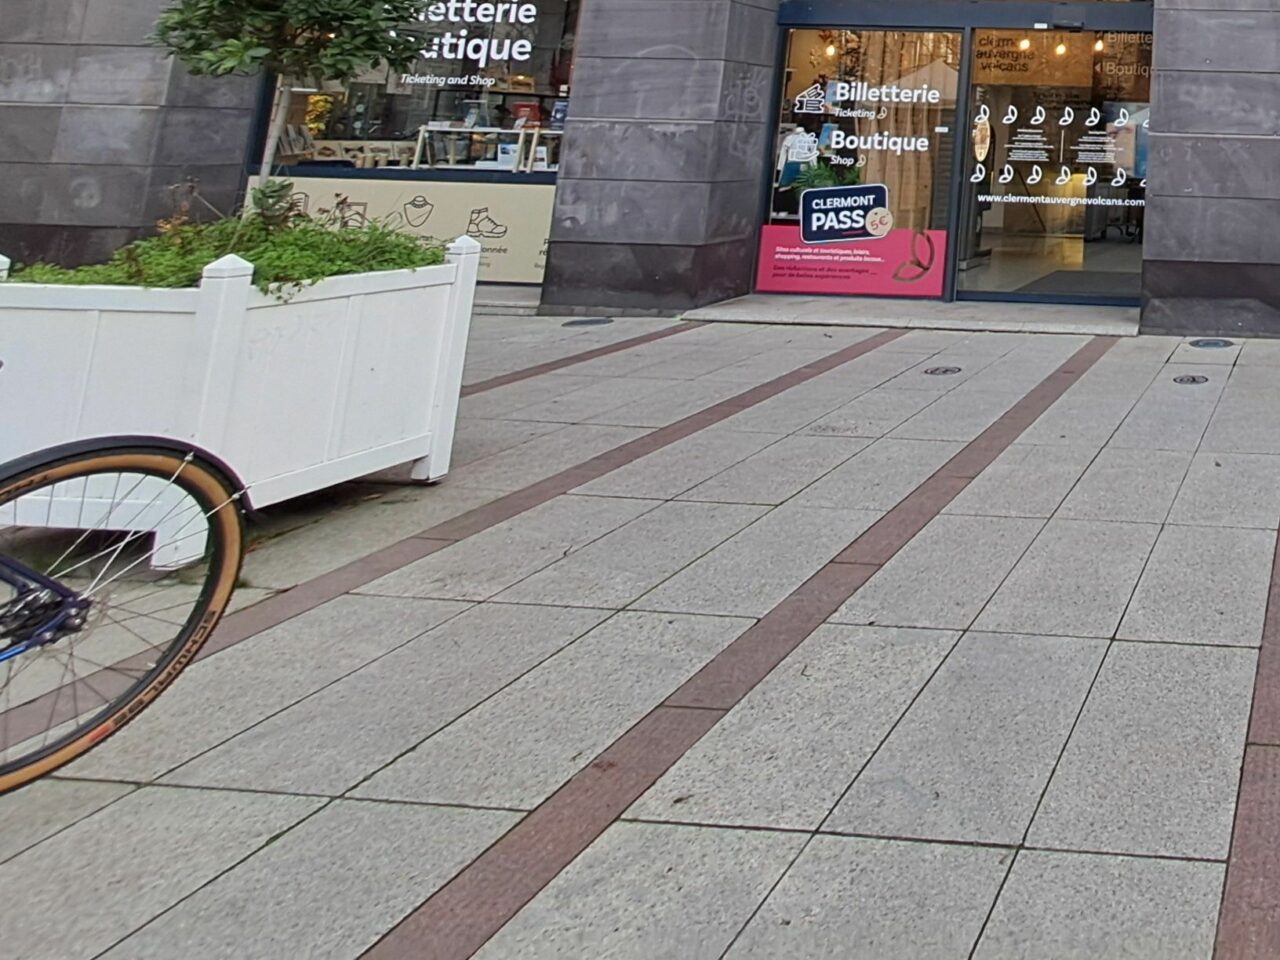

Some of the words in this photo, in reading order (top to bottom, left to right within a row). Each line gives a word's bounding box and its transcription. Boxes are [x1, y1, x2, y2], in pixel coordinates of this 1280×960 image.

[400, 73, 446, 85] Ticketing
[447, 74, 468, 85] and
[469, 75, 496, 87] Shop
[835, 83, 940, 104] Billetterie
[834, 108, 876, 121] Ticketing
[831, 131, 929, 155] Boutique
[830, 155, 855, 167] Shop
[812, 195, 875, 210] CLERMONT
[977, 193, 1146, 207] www.clermontauvergnevolcans.com
[811, 210, 865, 231] PASS
[481, 244, 508, 254] onnée
